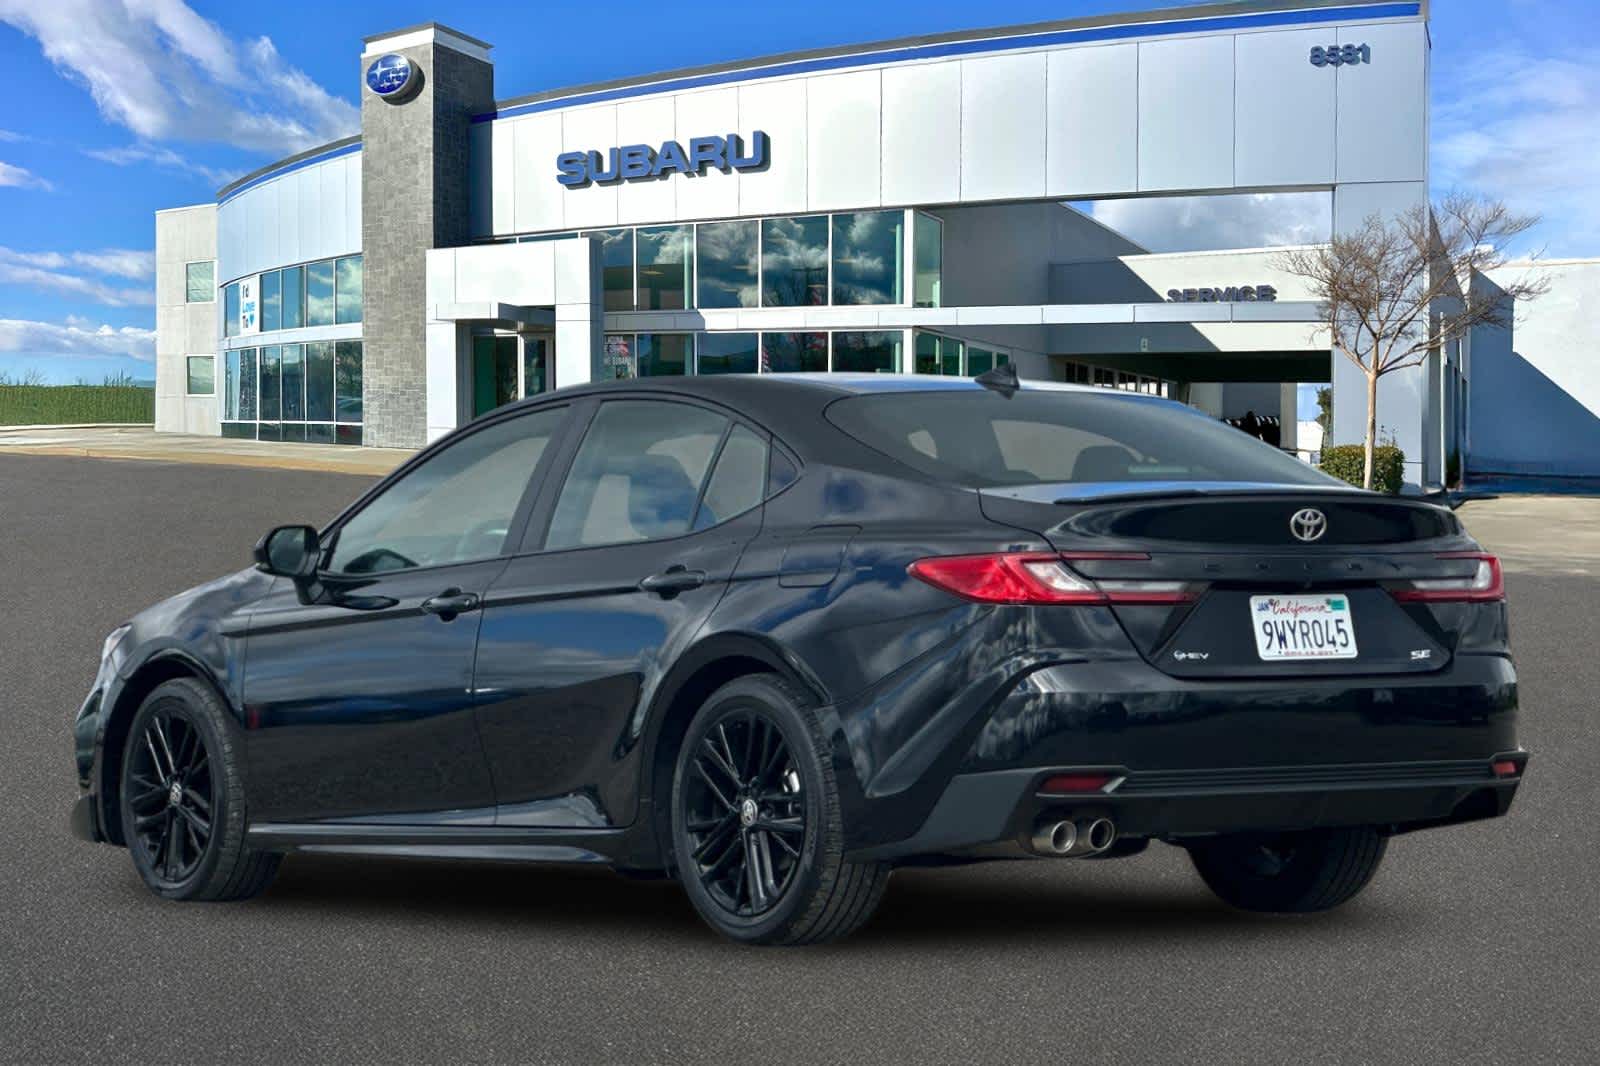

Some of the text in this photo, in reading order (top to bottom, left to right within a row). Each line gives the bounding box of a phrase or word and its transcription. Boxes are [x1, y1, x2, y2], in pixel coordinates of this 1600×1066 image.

[556, 129, 770, 190] SUBARU
[1166, 284, 1278, 303] SERVICE
[1272, 599, 1326, 619] California
